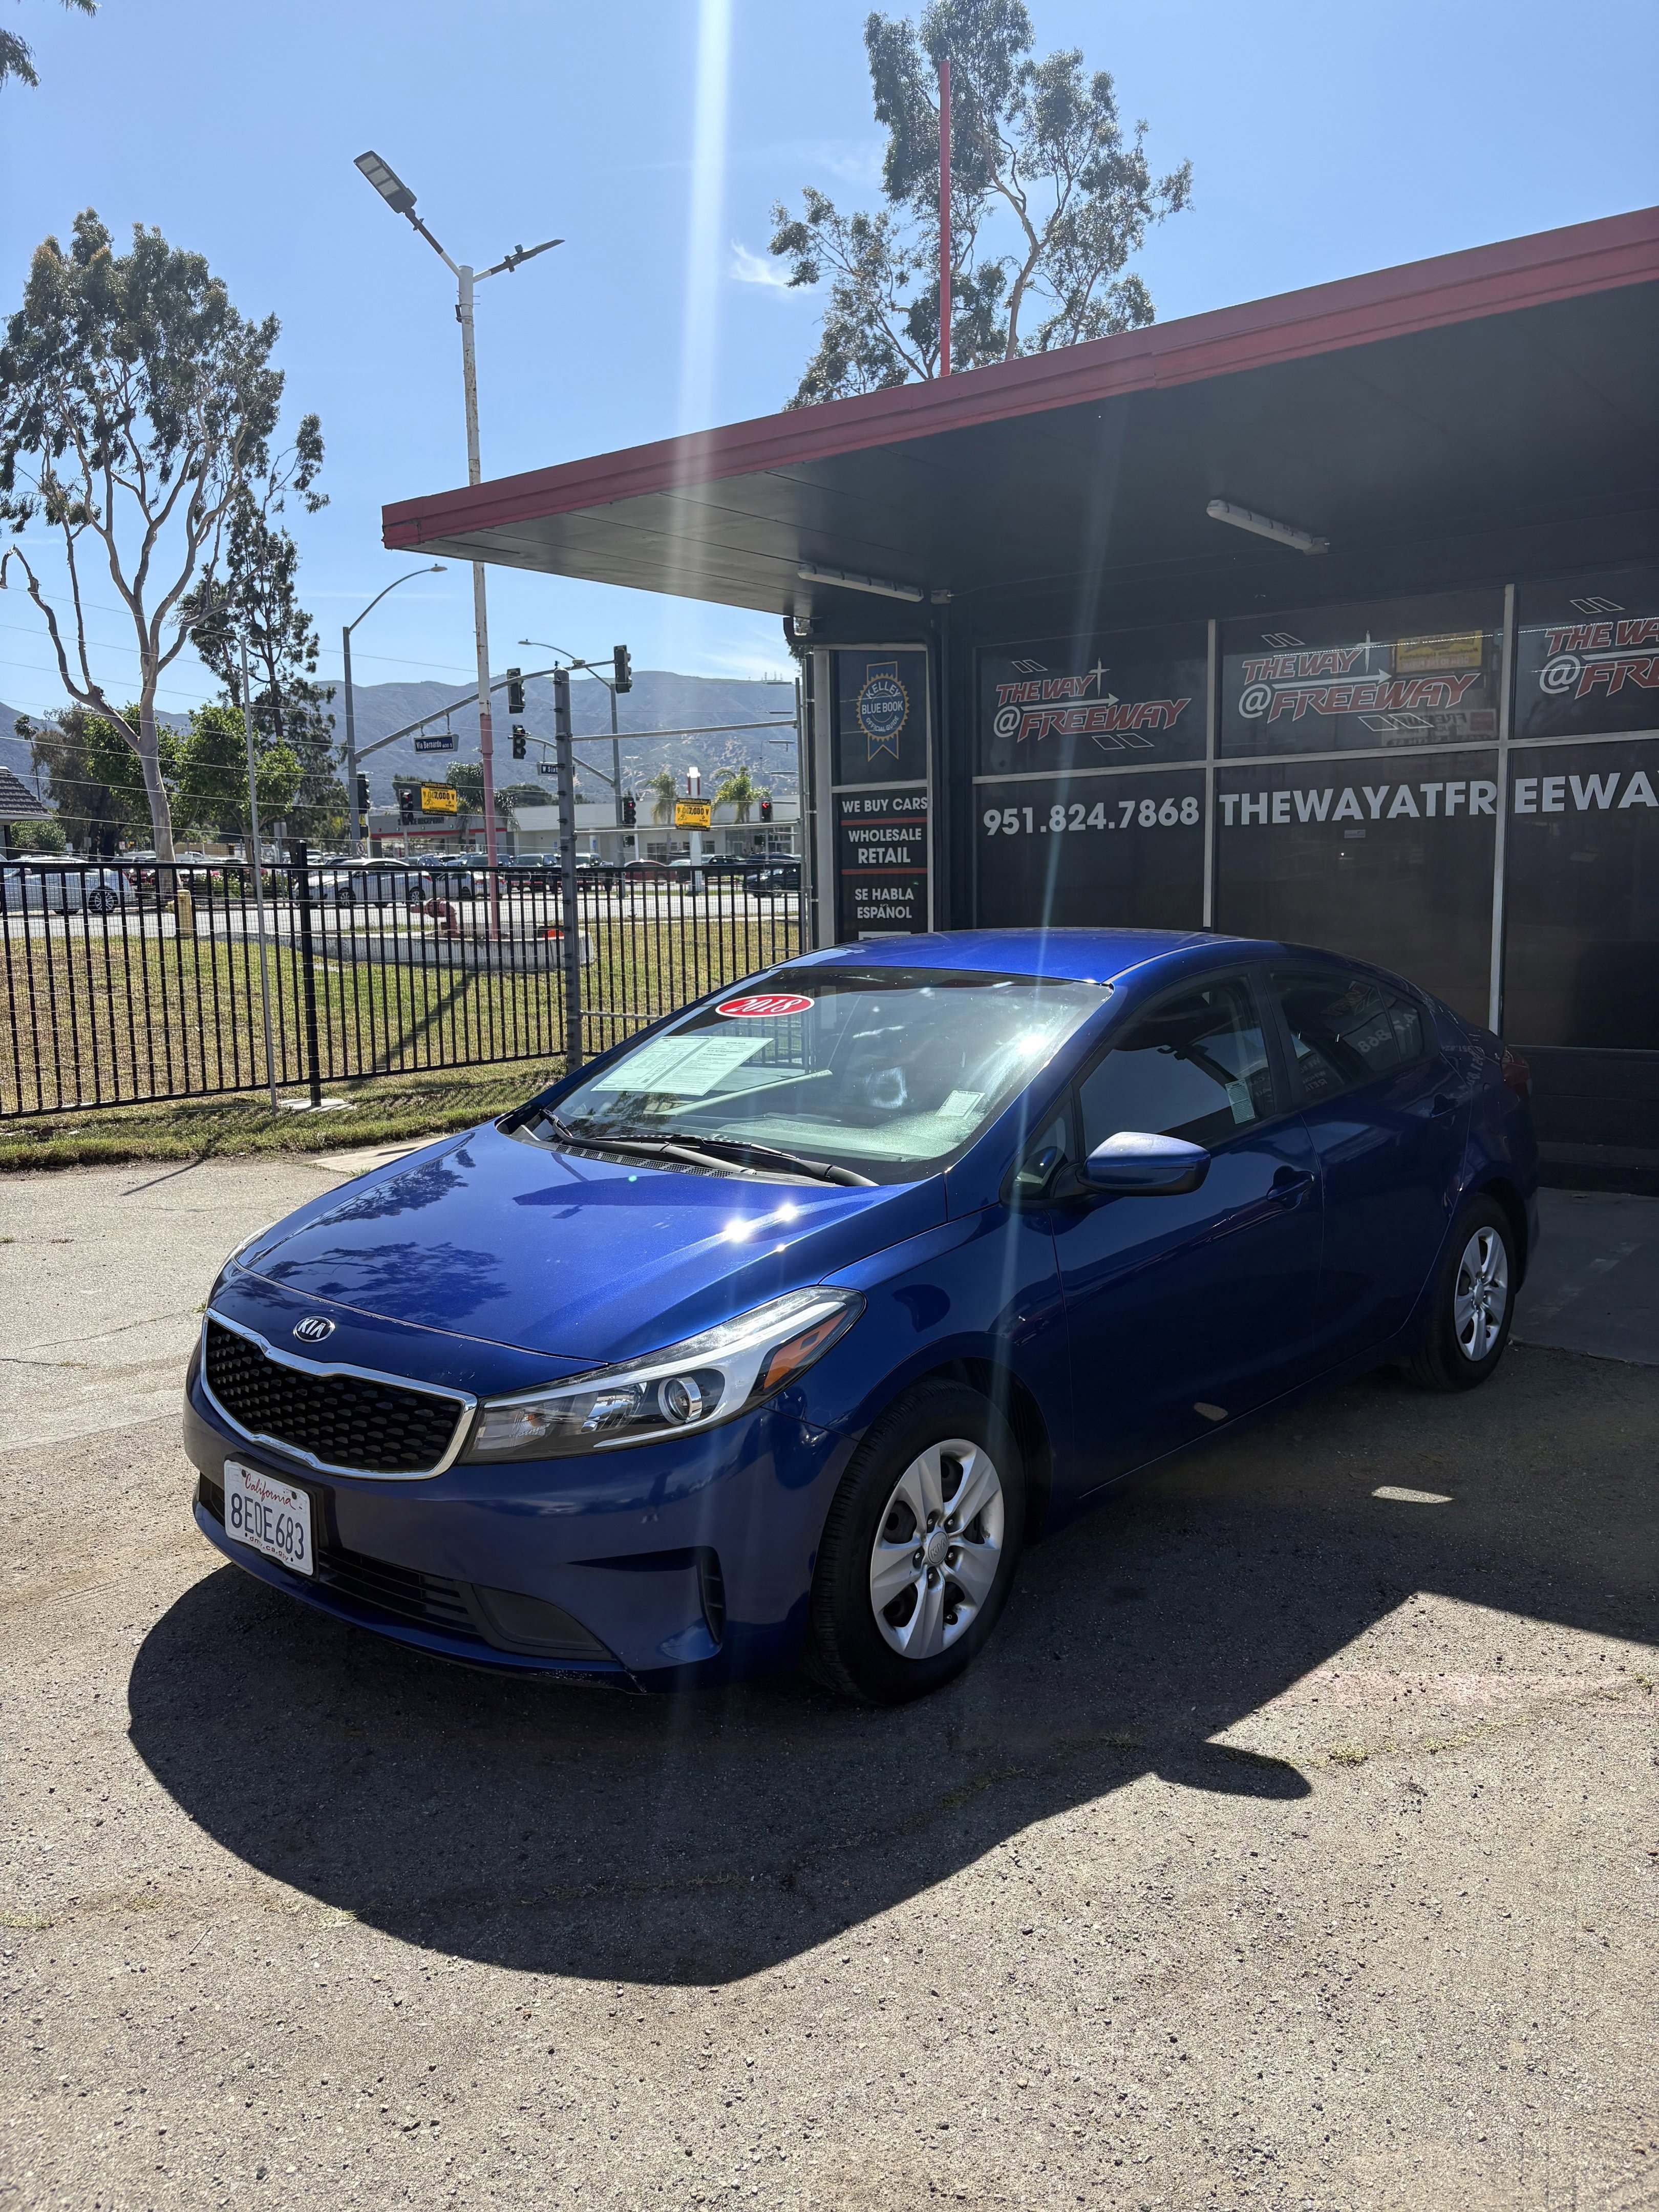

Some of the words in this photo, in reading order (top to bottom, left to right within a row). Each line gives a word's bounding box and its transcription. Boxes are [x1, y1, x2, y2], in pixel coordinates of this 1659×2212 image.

[1615, 618, 1659, 646] WA
[1242, 656, 1295, 685] THE
[1298, 650, 1363, 676] WAY
[866, 681, 900, 699] KELLEY
[996, 680, 1040, 707] THE
[1042, 675, 1096, 699] WAY
[1239, 673, 1481, 724] @FREEWAY
[862, 703, 881, 714] BLUE
[882, 700, 903, 712] BOOK
[866, 717, 886, 732] OFFICIAL
[886, 715, 900, 730] GUIDE
[993, 698, 1192, 743] @FREEWAY
[423, 740, 441, 749] Bernardo
[434, 792, 450, 800] 7,000
[842, 801, 860, 813] WE
[864, 799, 889, 812] BUY
[892, 797, 928, 811] CARS
[1219, 771, 1659, 825] THEWAYATFREEWA
[983, 796, 1199, 836] 951.824.7868
[848, 828, 922, 842] WHOLESALE
[858, 847, 911, 864] RETAIL
[855, 888, 868, 900] SE
[872, 888, 914, 900] HABLA
[857, 904, 912, 919] ESPAÑOL
[725, 998, 802, 1012] 2018
[297, 1318, 326, 1338] KIA
[245, 1473, 296, 1510] California
[249, 1536, 289, 1562] dmv.ca.gov
[930, 1538, 947, 1559] KIA
